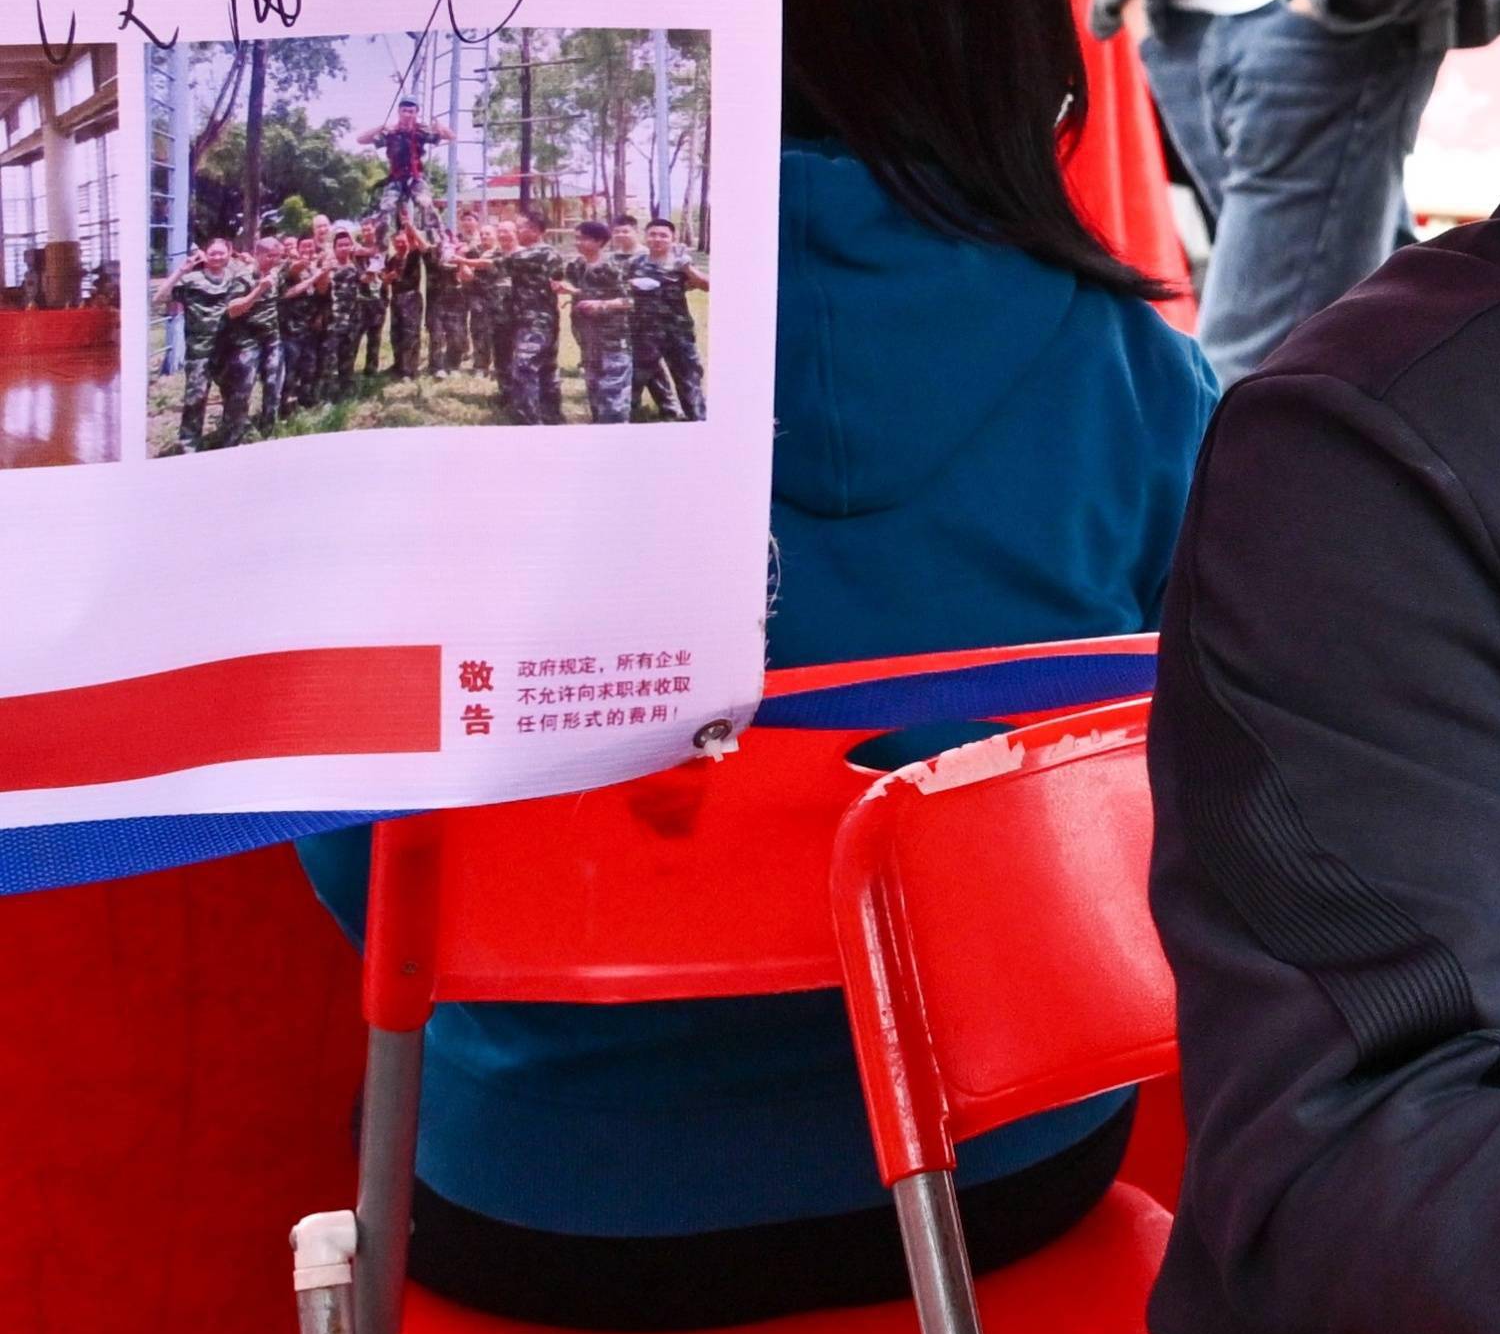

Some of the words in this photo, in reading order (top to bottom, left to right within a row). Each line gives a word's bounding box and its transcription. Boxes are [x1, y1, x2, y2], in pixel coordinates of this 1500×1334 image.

[517, 650, 692, 678] 政府规定，所有企业
[459, 660, 494, 736] 敬告
[517, 676, 691, 706] 不允许向求职者收取
